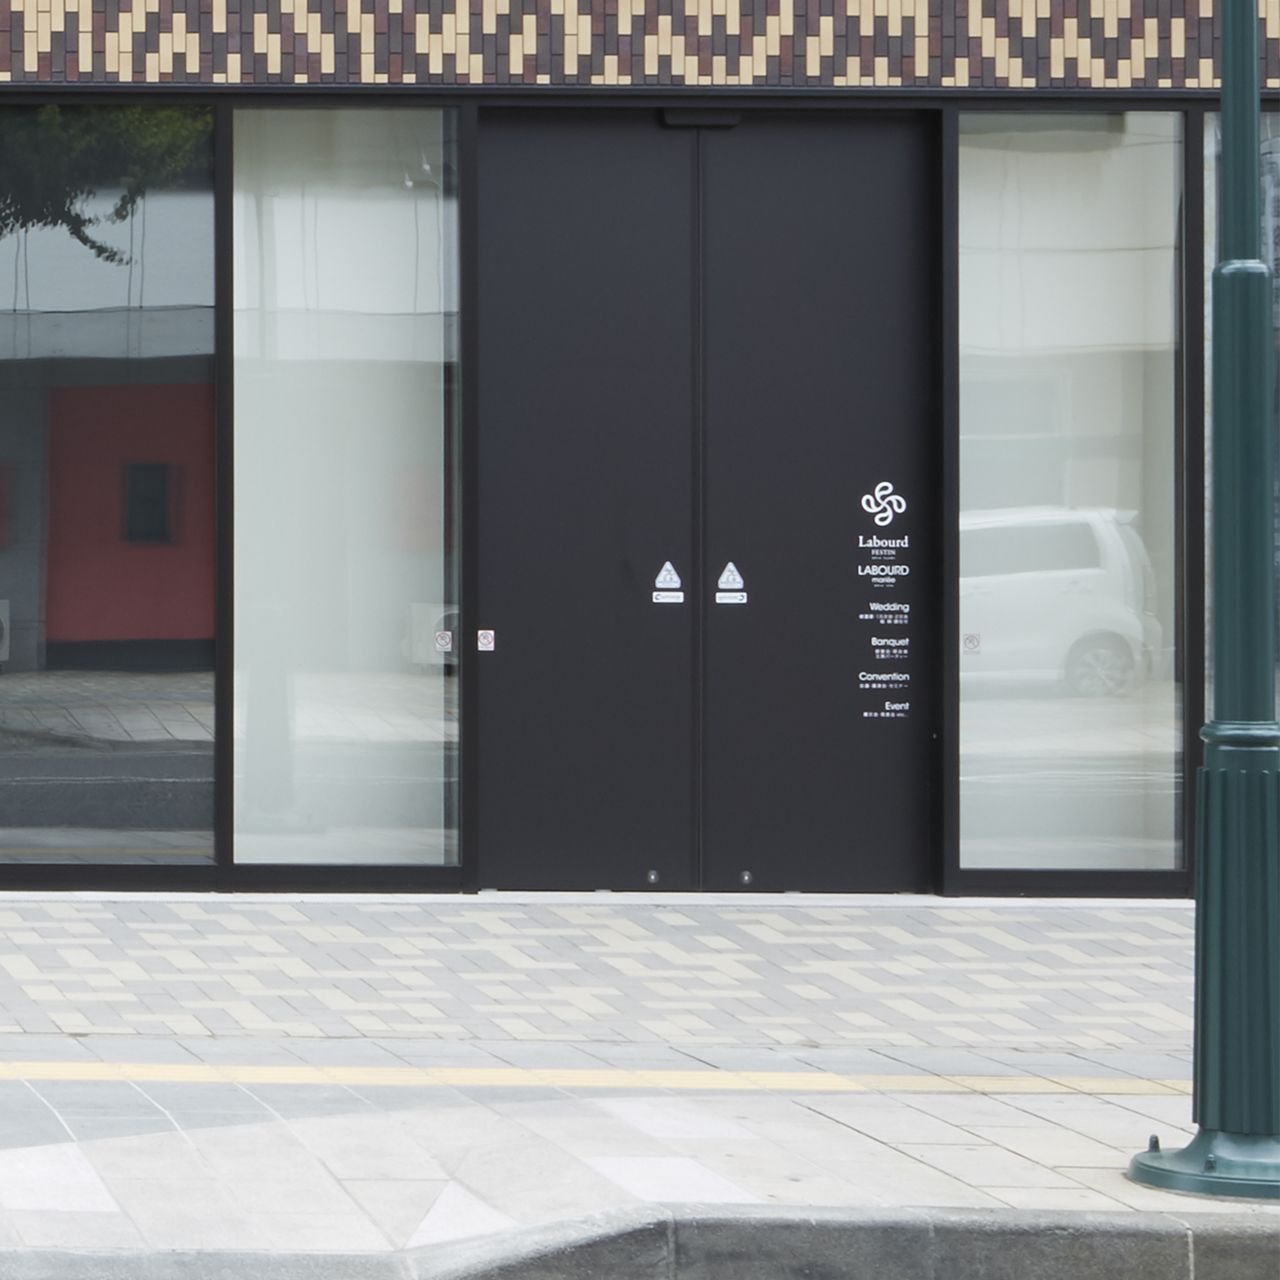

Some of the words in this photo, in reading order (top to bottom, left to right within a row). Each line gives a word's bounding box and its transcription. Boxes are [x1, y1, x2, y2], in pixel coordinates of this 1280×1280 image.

[859, 535, 908, 547] Labourd
[858, 565, 909, 575] LABOURD
[869, 602, 909, 613] Wedding
[871, 637, 909, 646] Banquet
[859, 672, 909, 680] Convention
[885, 702, 909, 710] Event
